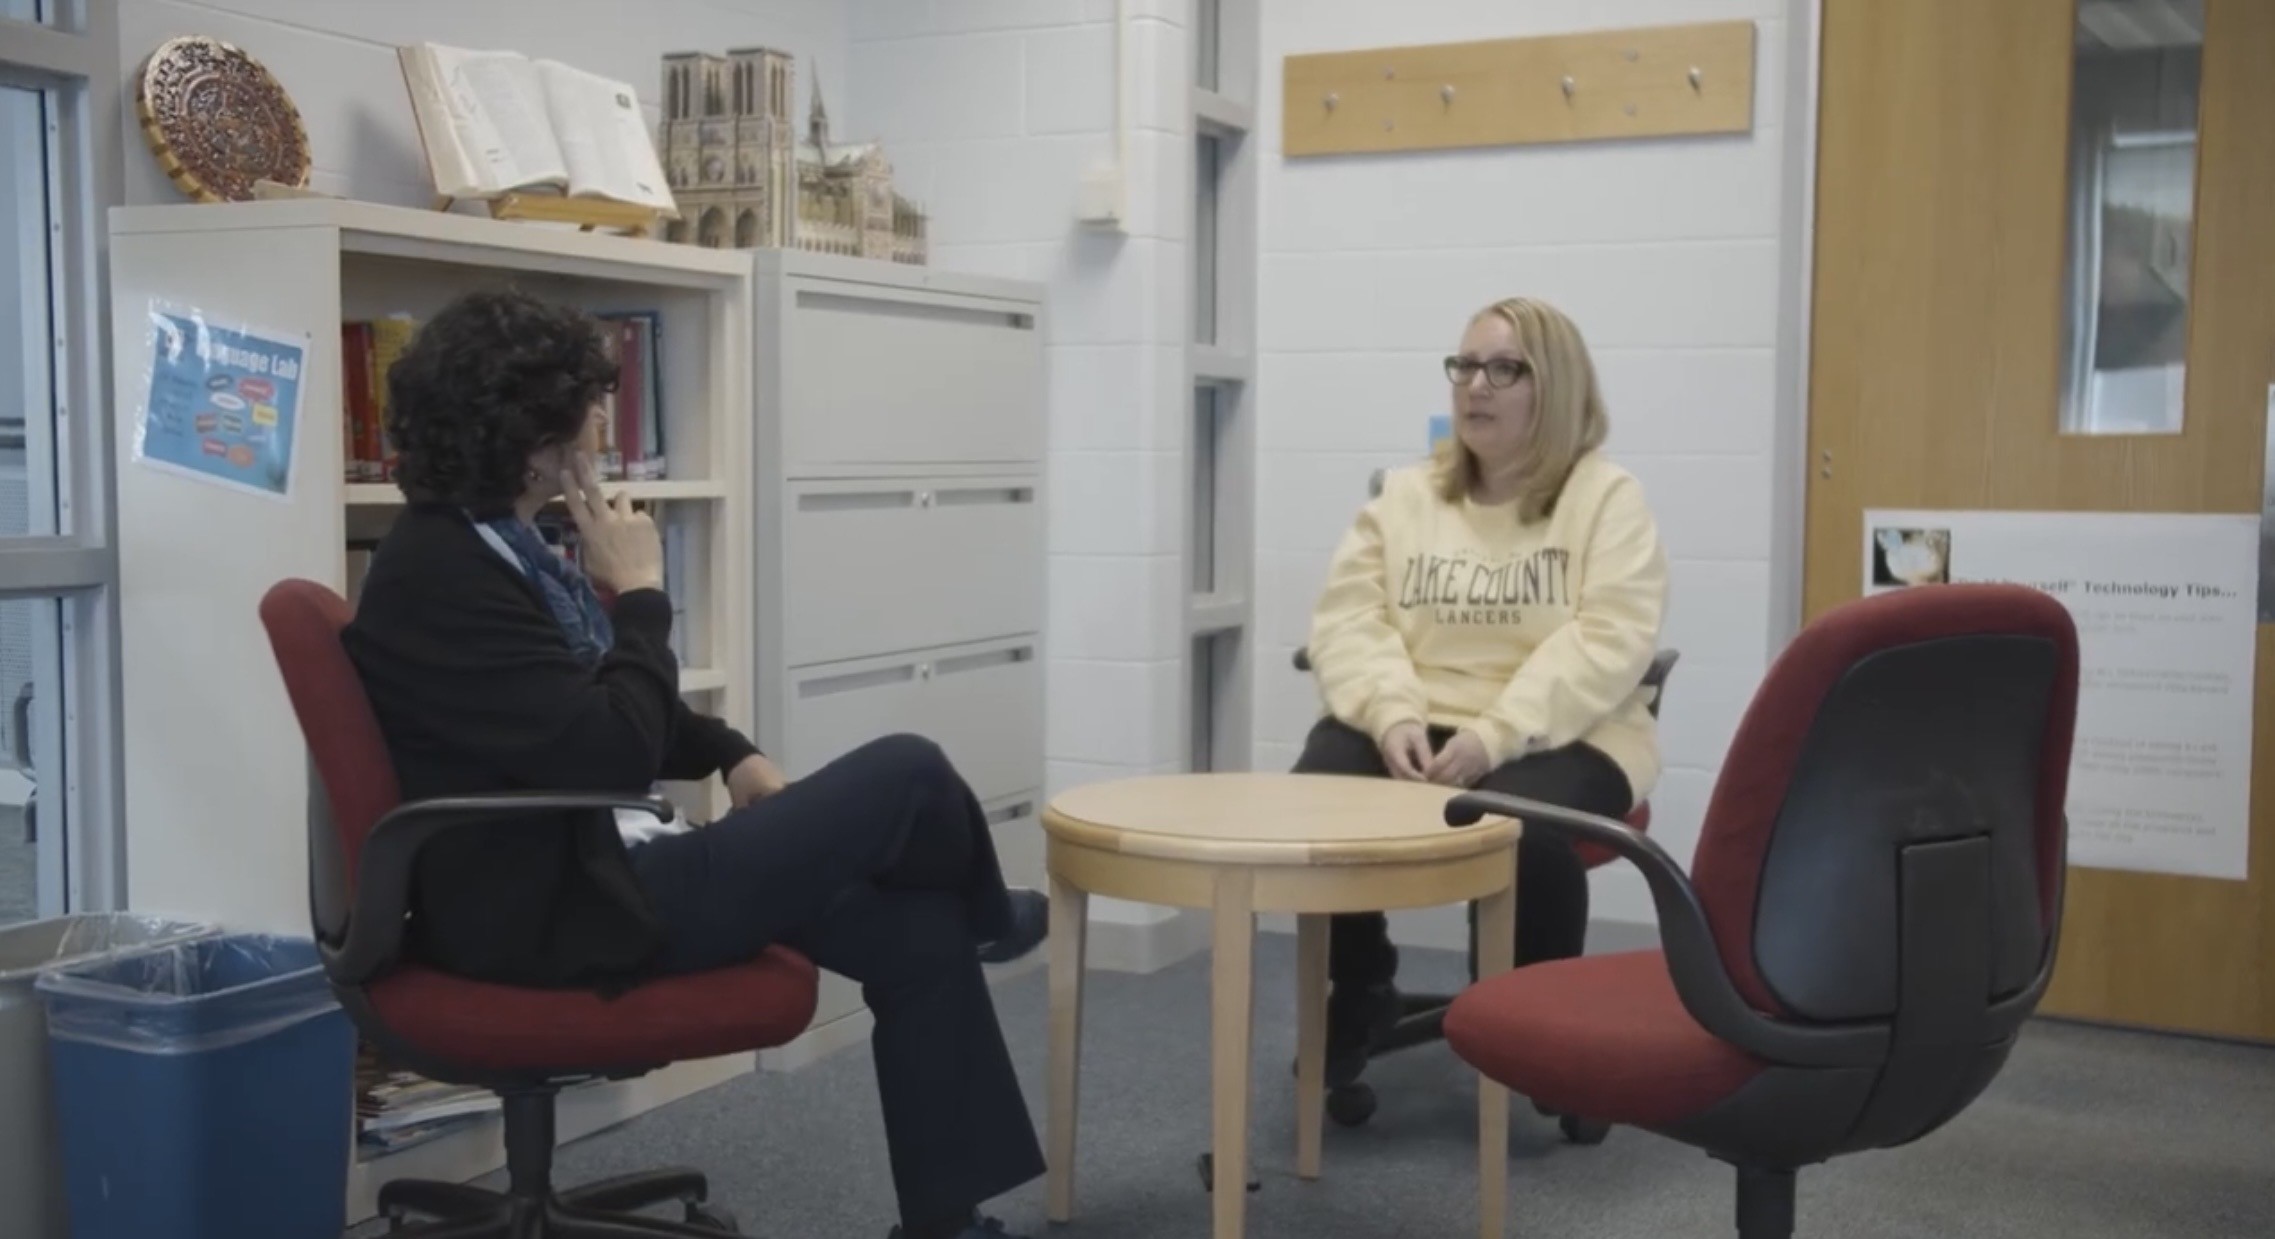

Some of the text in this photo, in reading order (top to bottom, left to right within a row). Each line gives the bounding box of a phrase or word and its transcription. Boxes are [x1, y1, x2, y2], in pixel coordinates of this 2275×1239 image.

[270, 353, 298, 380] Lab
[1399, 546, 1569, 609] LAKE COUNTY
[2083, 580, 2178, 598] Technology
[2185, 582, 2238, 598] Tips...
[1435, 609, 1522, 624] LANCERS
